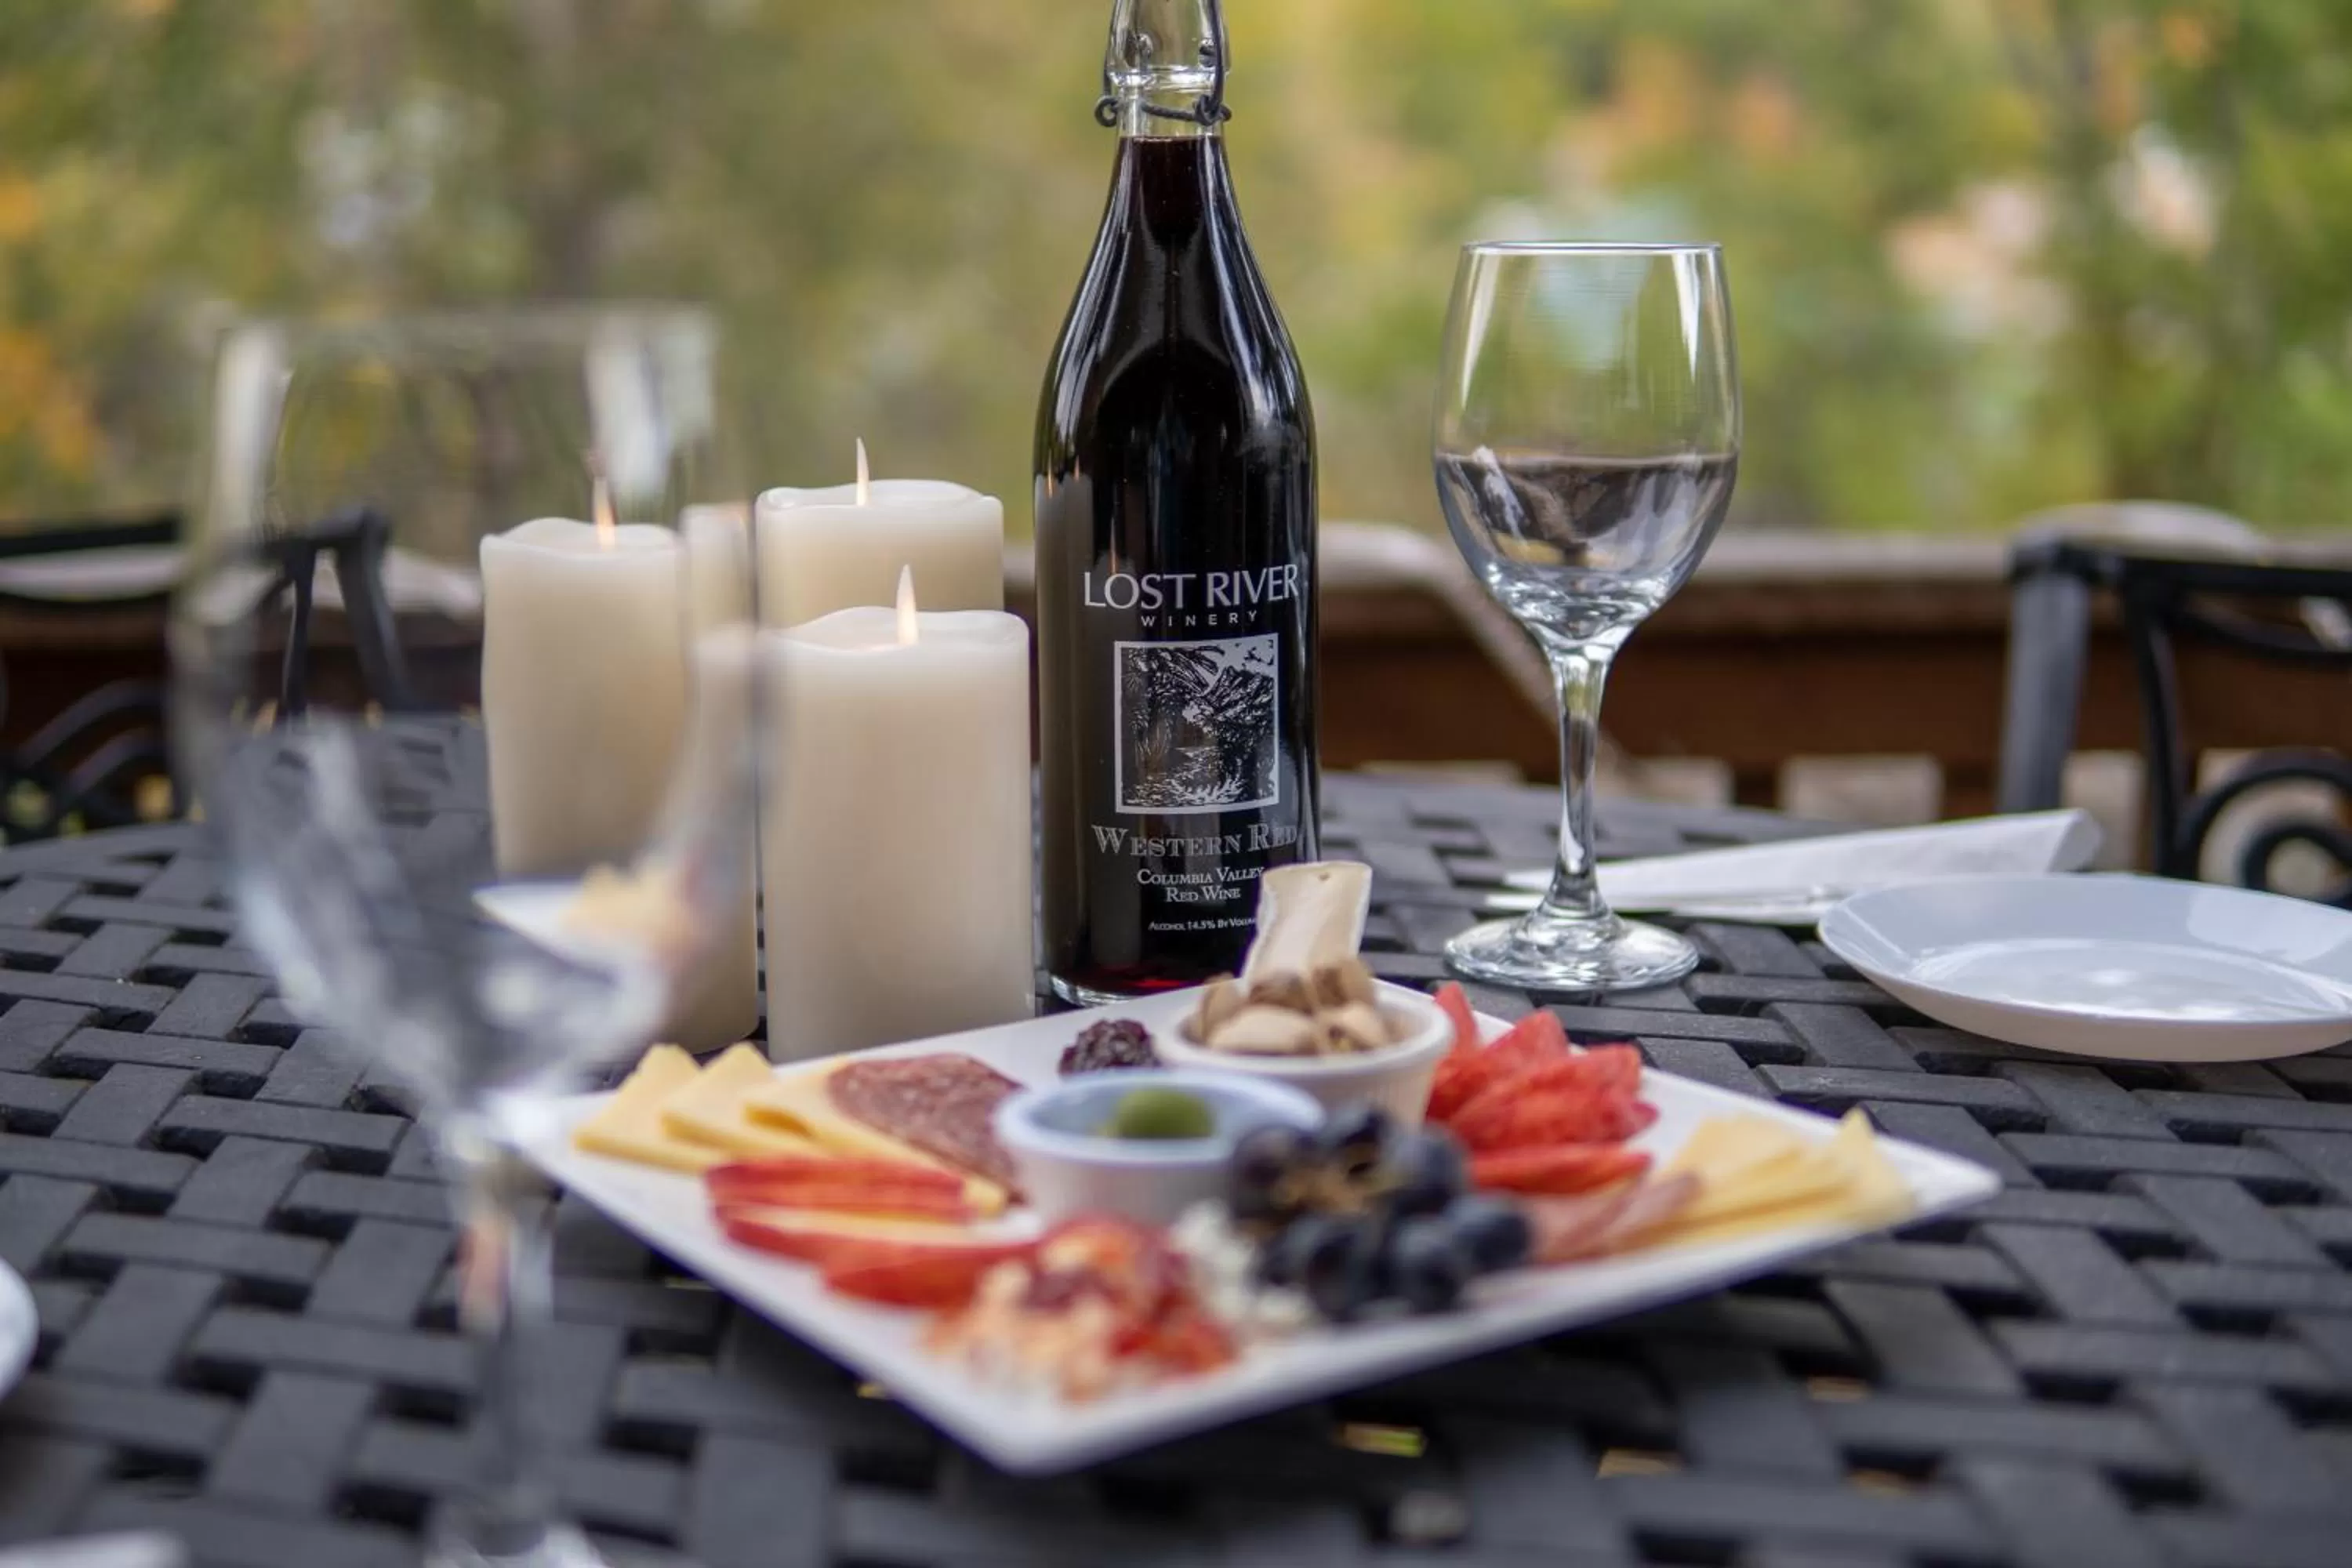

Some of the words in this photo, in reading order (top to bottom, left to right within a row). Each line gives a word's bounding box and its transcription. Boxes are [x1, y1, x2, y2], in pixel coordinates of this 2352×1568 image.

[1084, 572, 1196, 609] LOST
[1207, 564, 1298, 608] RIVER
[1141, 610, 1258, 626] WINERY
[1091, 825, 1243, 857] WESTERN
[1247, 823, 1298, 852] RED
[1137, 869, 1212, 885] COLUMBIA
[1216, 867, 1264, 883] VALLEY
[1166, 887, 1199, 902] RED
[1201, 886, 1241, 901] WINE
